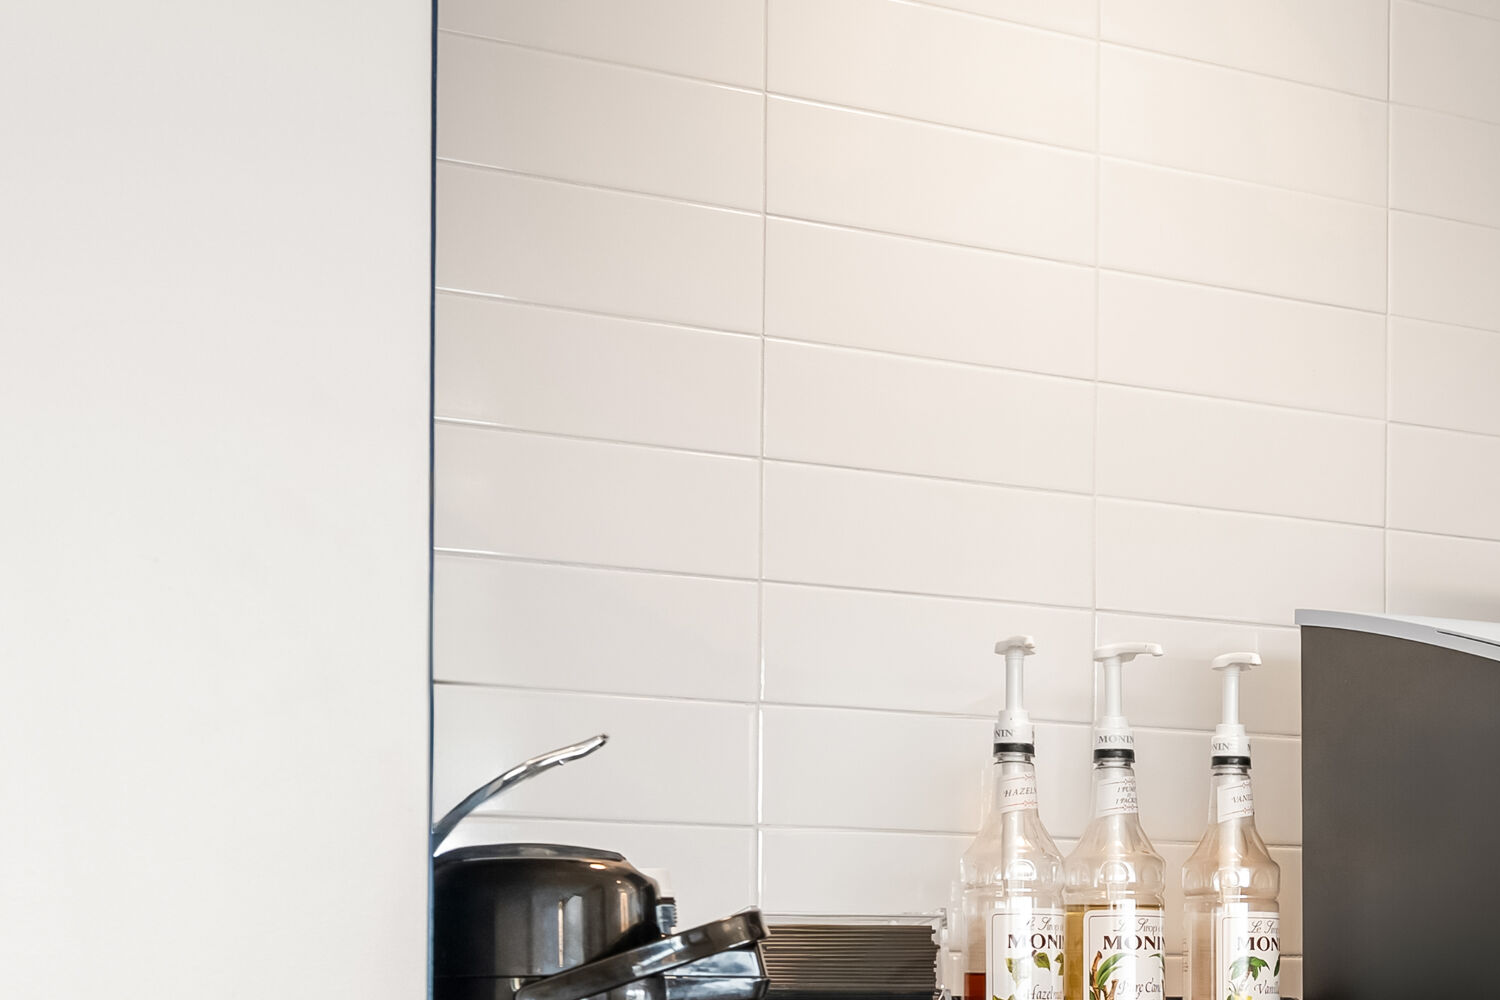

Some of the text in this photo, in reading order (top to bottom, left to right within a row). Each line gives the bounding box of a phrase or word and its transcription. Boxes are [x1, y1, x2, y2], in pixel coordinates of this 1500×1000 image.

[995, 729, 1013, 738] NIN
[1213, 742, 1230, 752] NIN
[1004, 786, 1037, 798] HAZEL
[1007, 933, 1064, 950] MONI
[1237, 935, 1280, 952] MON
[1027, 983, 1062, 1000] Hazeln
